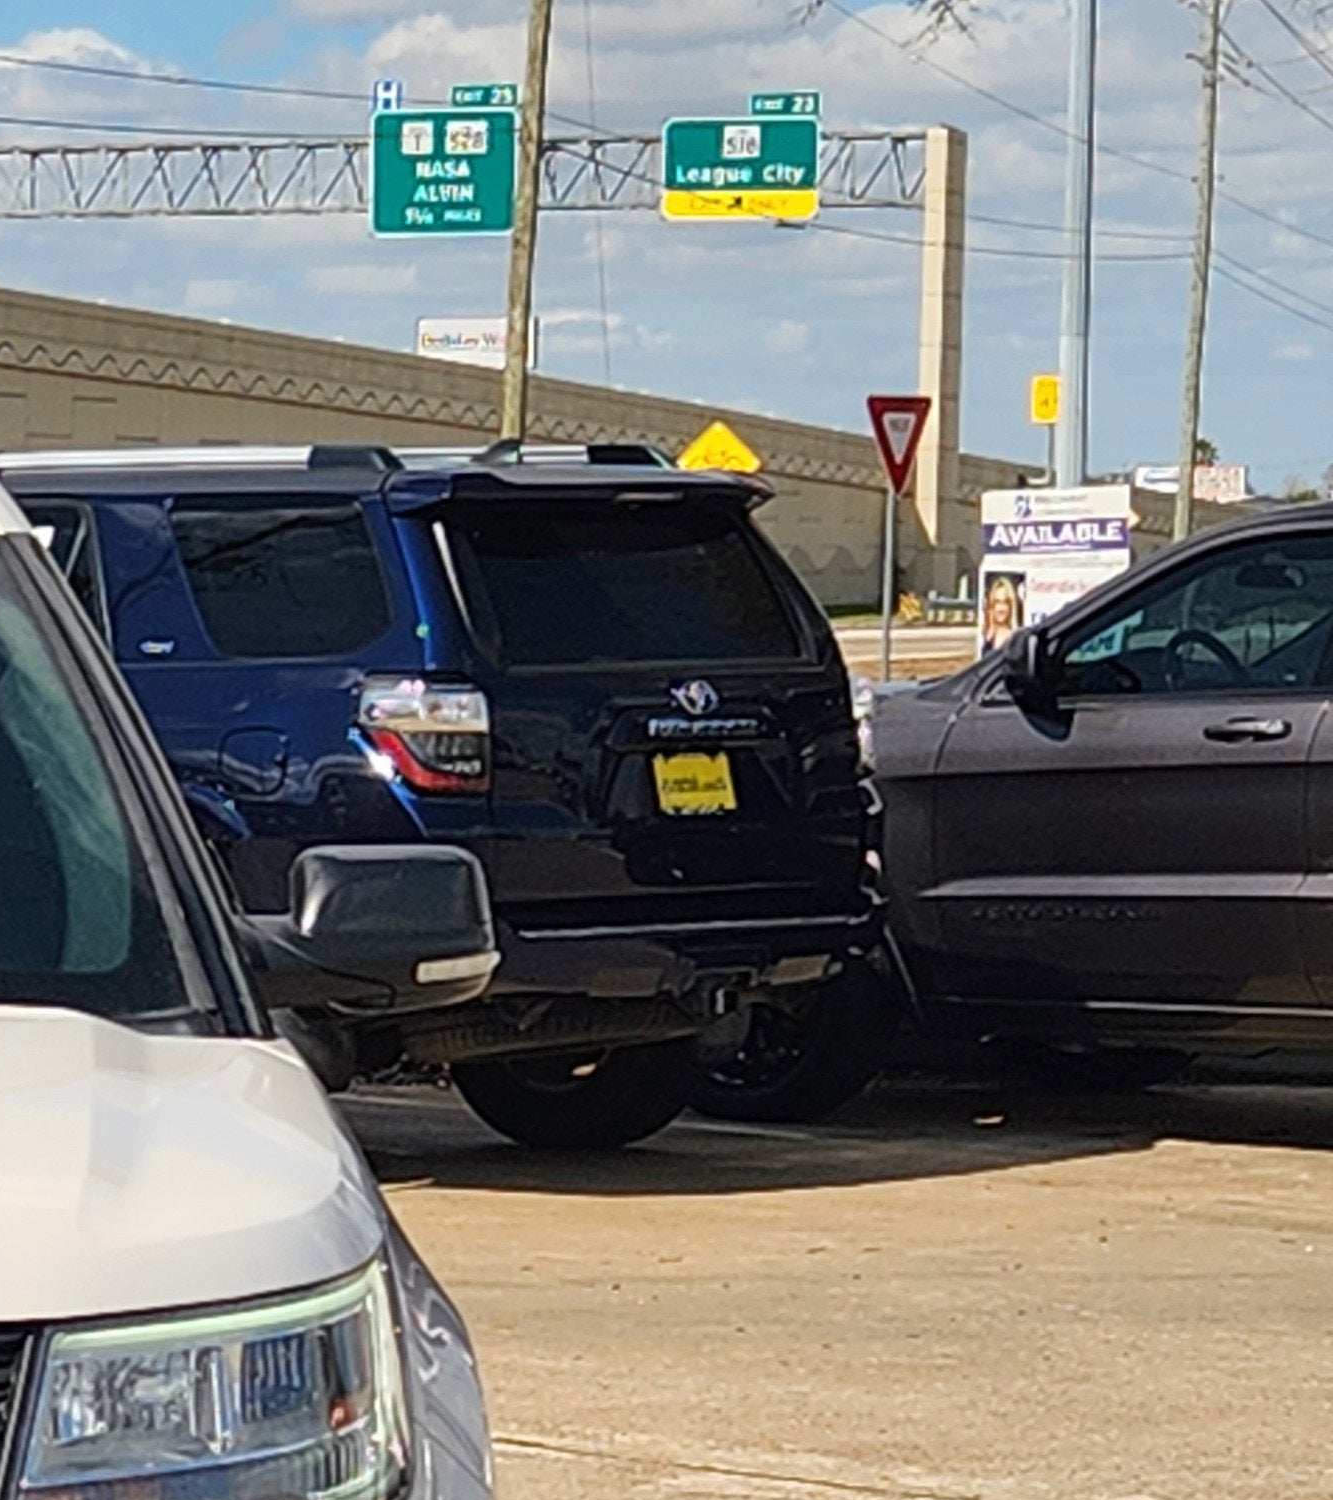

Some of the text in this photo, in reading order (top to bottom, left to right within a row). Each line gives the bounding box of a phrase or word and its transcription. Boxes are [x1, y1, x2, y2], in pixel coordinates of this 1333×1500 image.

[416, 160, 471, 179] NASA
[676, 163, 806, 187] League City
[413, 184, 475, 202] ALVIN
[989, 521, 1124, 547] AVAILABLE
